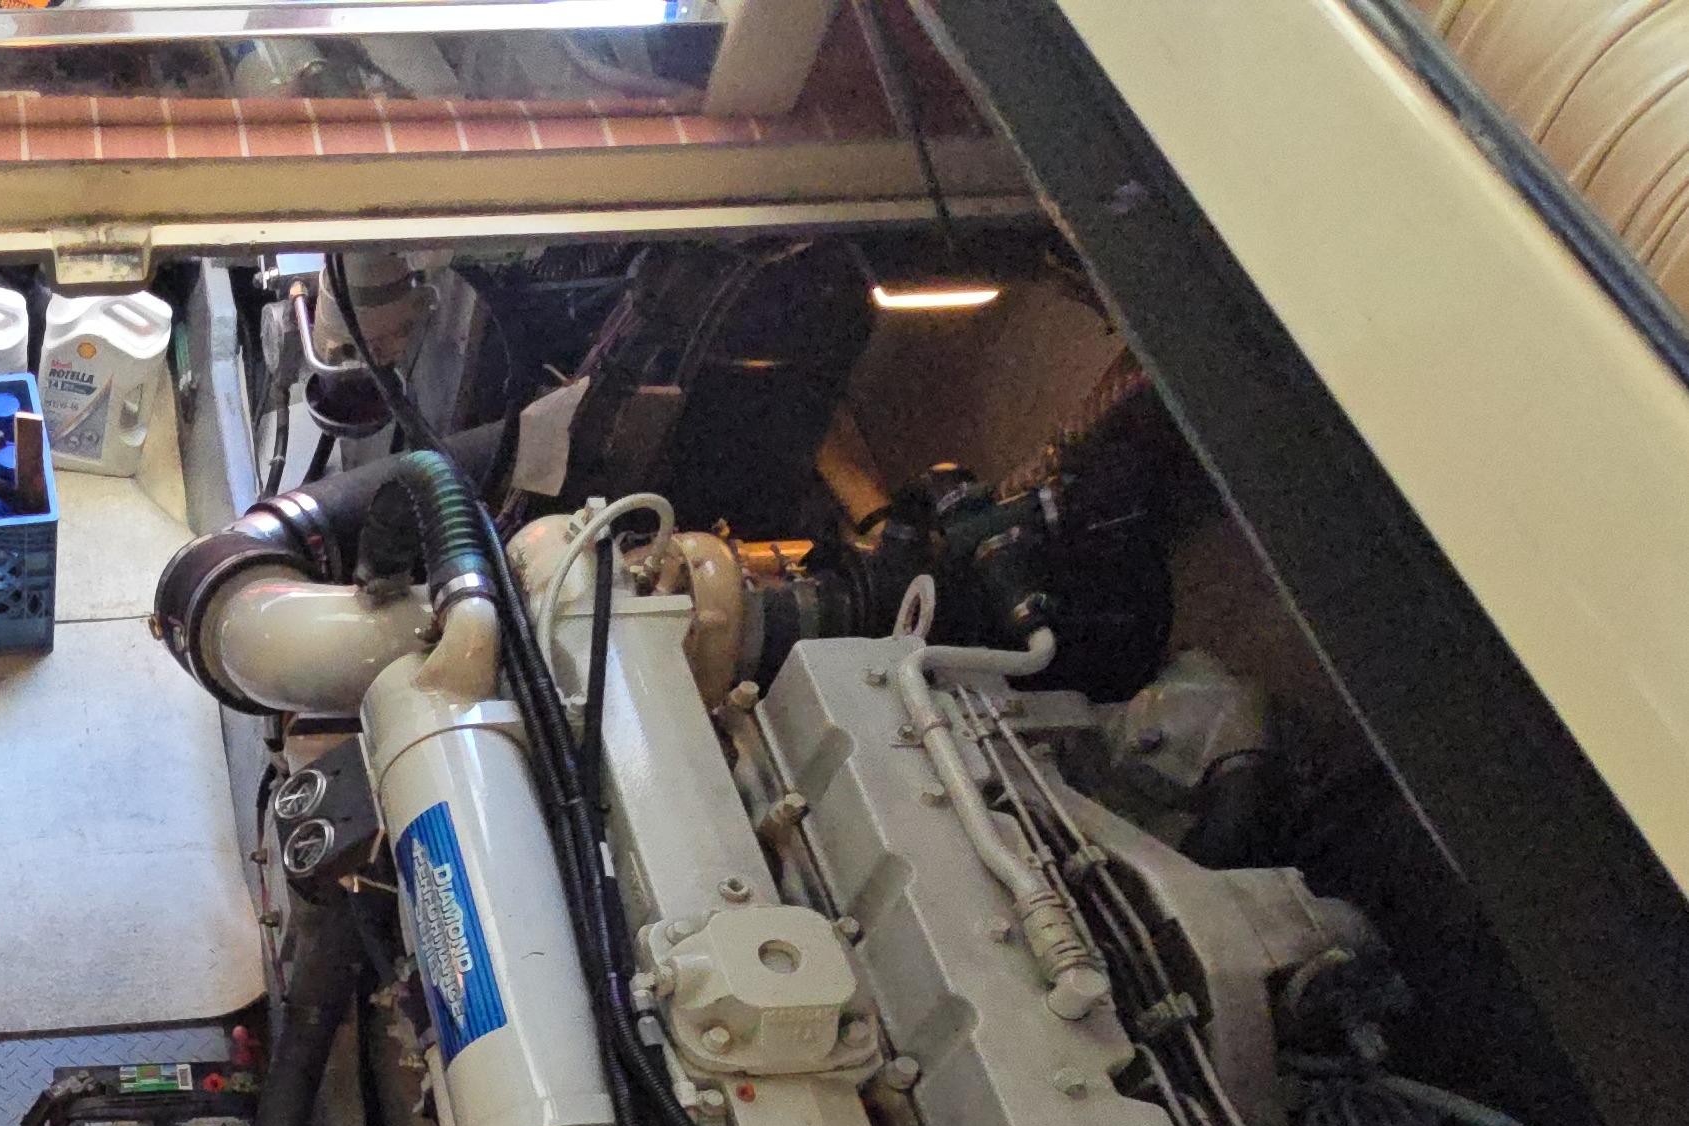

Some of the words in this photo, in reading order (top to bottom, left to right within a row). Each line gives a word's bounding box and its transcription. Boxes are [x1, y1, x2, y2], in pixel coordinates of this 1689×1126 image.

[49, 368, 95, 383] ROTELLA
[413, 852, 465, 1018] PERFORMANCE
[432, 863, 473, 974] DIAMOND
